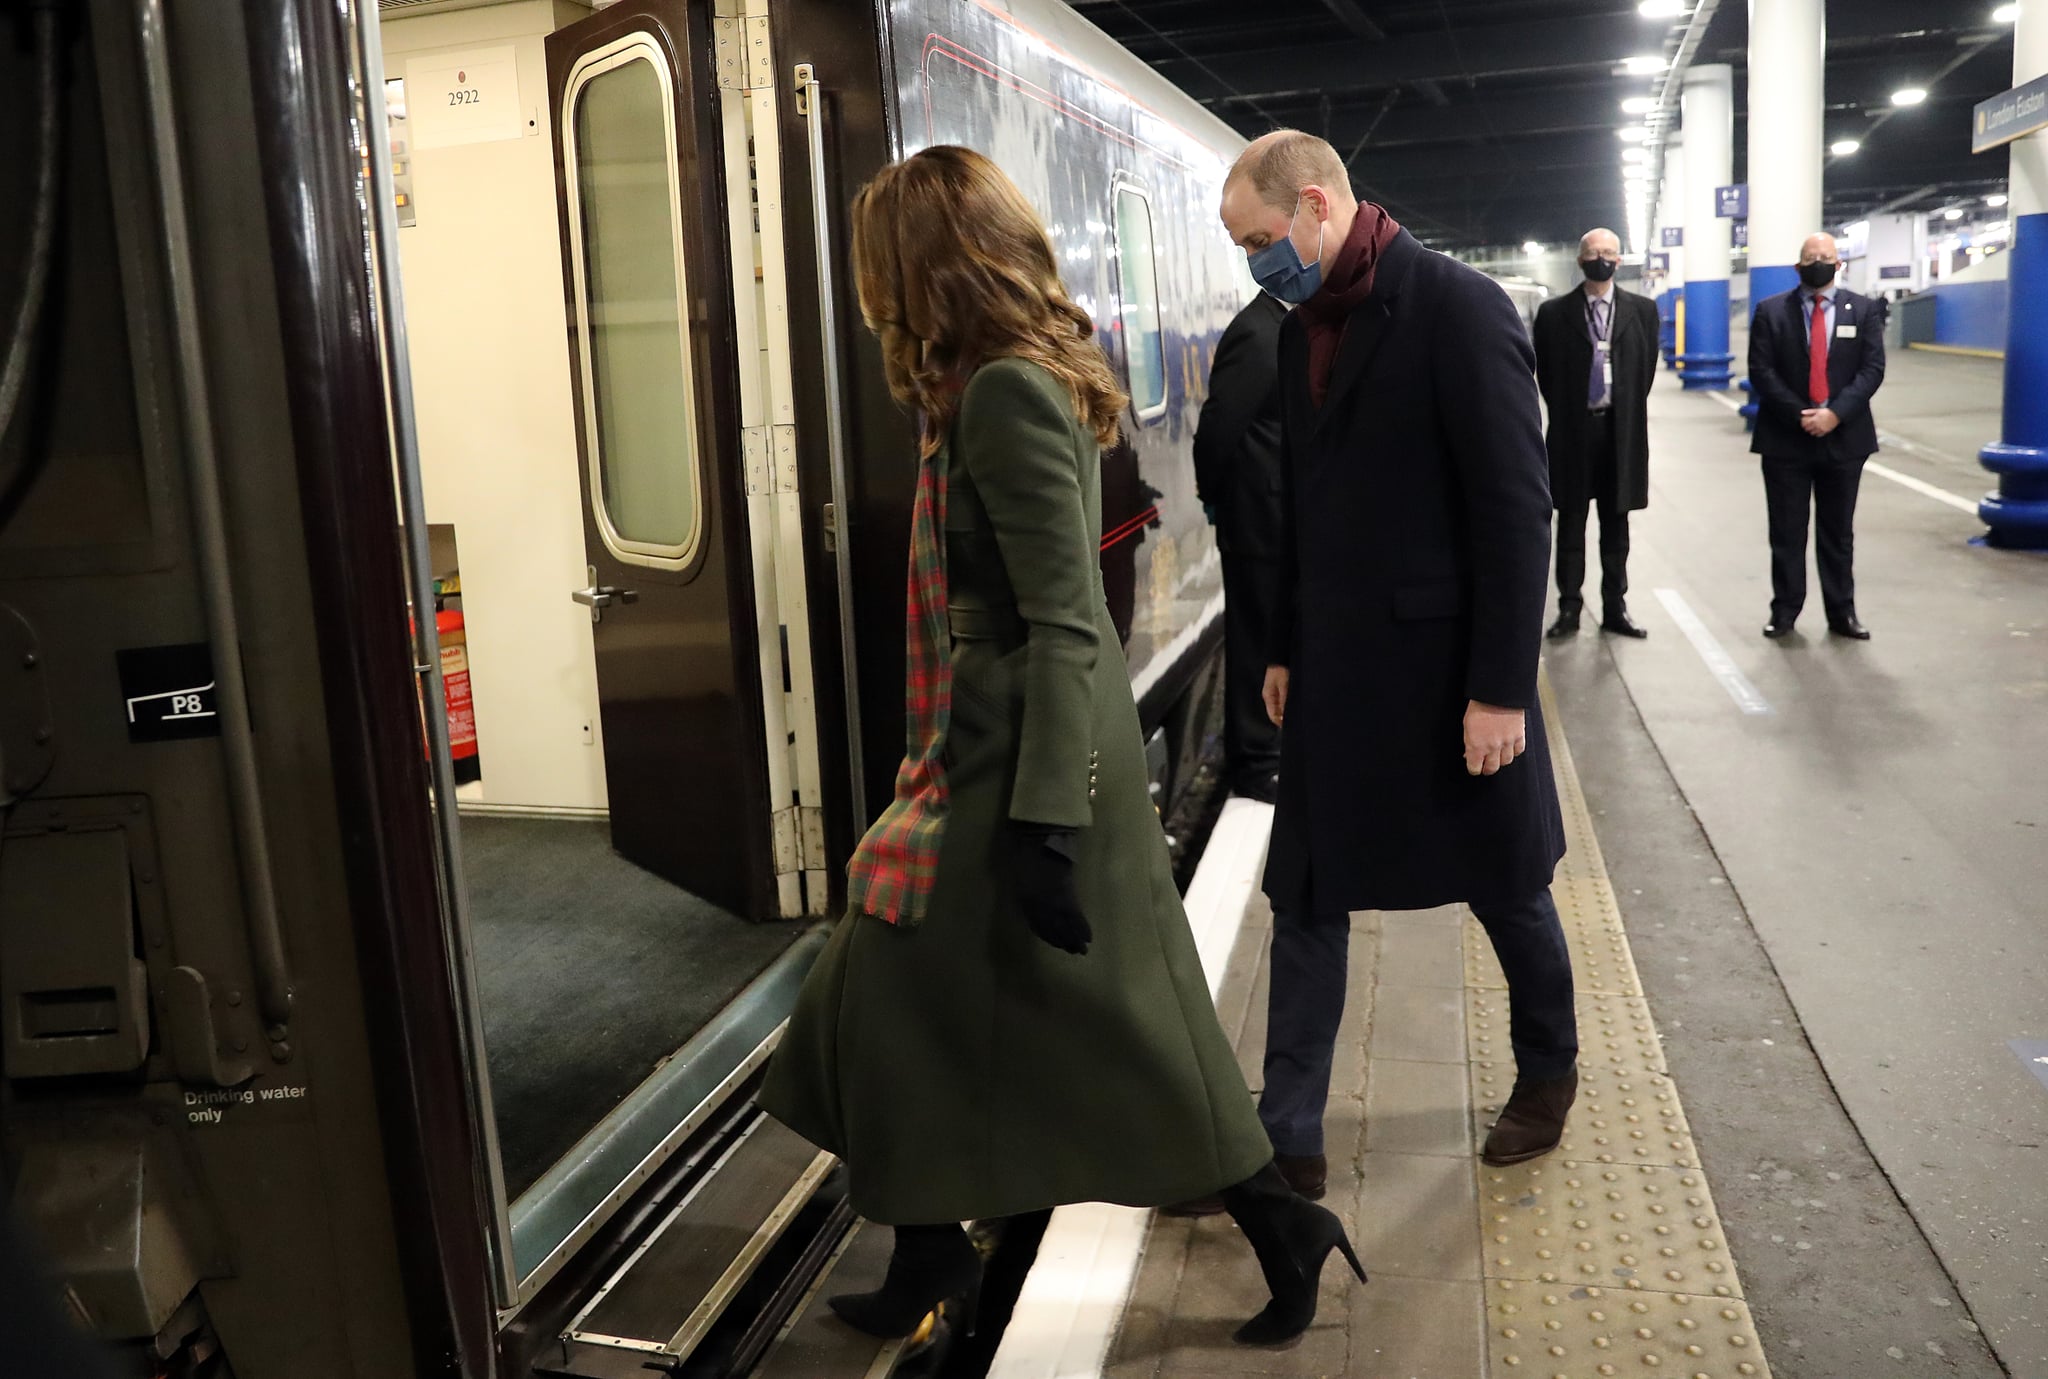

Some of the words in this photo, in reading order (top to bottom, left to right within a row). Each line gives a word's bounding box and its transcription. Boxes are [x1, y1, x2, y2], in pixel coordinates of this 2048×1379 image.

[448, 89, 480, 106] 2922
[1987, 103, 2015, 130] London
[2017, 91, 2045, 118] Euston
[440, 649, 461, 659] hubb
[172, 694, 203, 715] P8
[184, 1089, 254, 1105] Drinking
[259, 1085, 306, 1100] water
[188, 1107, 222, 1123] only
